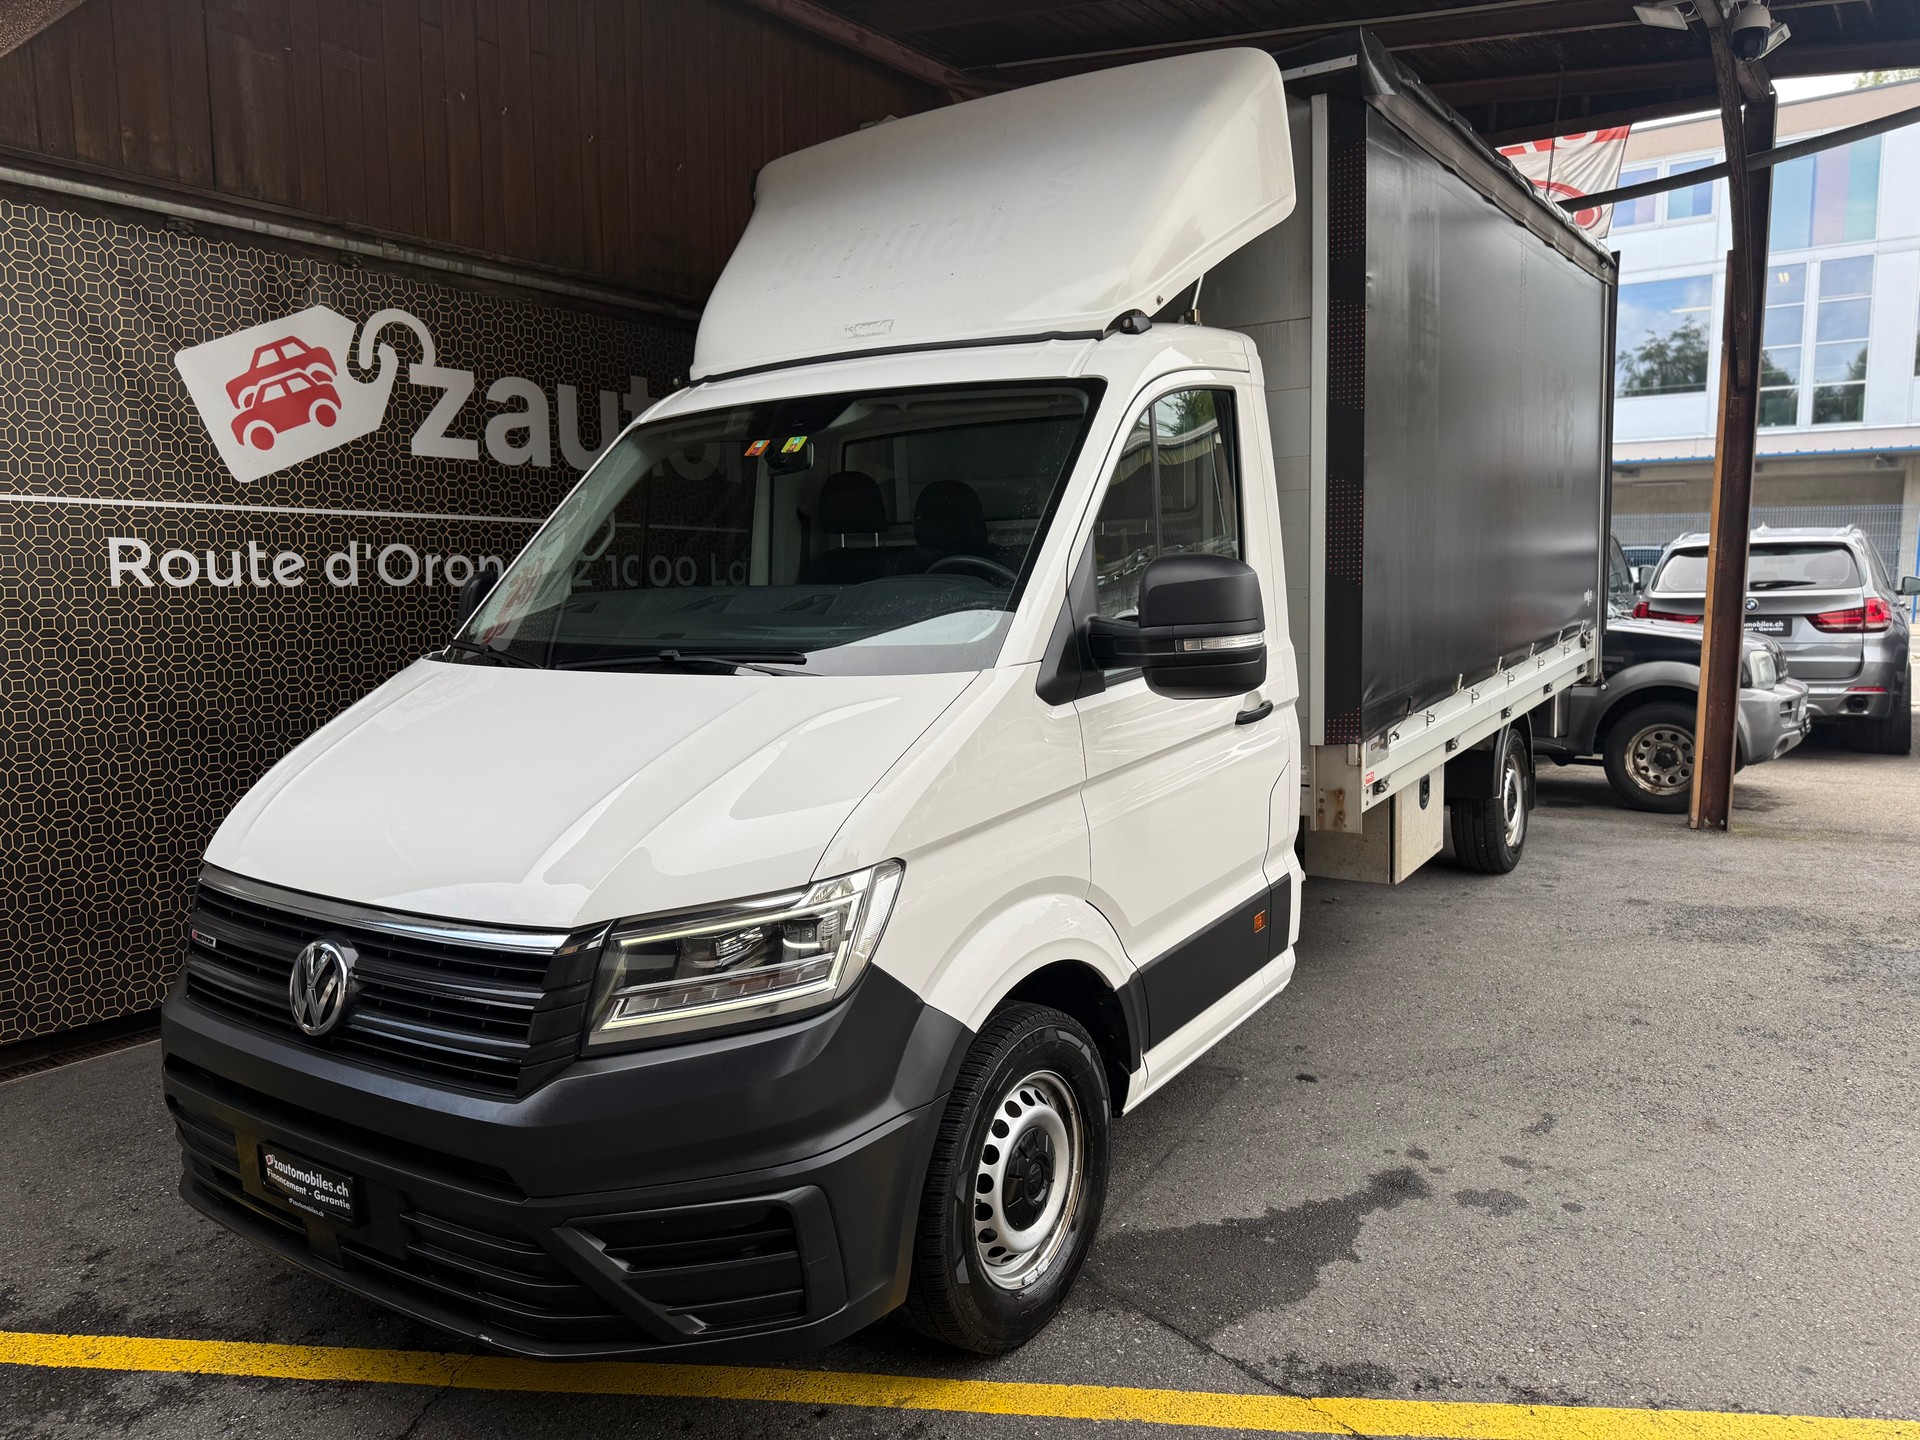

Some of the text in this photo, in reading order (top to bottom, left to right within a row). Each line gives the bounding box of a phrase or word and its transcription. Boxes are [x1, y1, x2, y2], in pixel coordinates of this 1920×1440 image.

[108, 536, 305, 588] Route
[325, 540, 504, 588] d'Oron
[711, 552, 748, 587] La
[266, 1167, 307, 1196] Financement
[313, 1189, 352, 1211] Garantie
[273, 1160, 350, 1198] zautomobiles.ch
